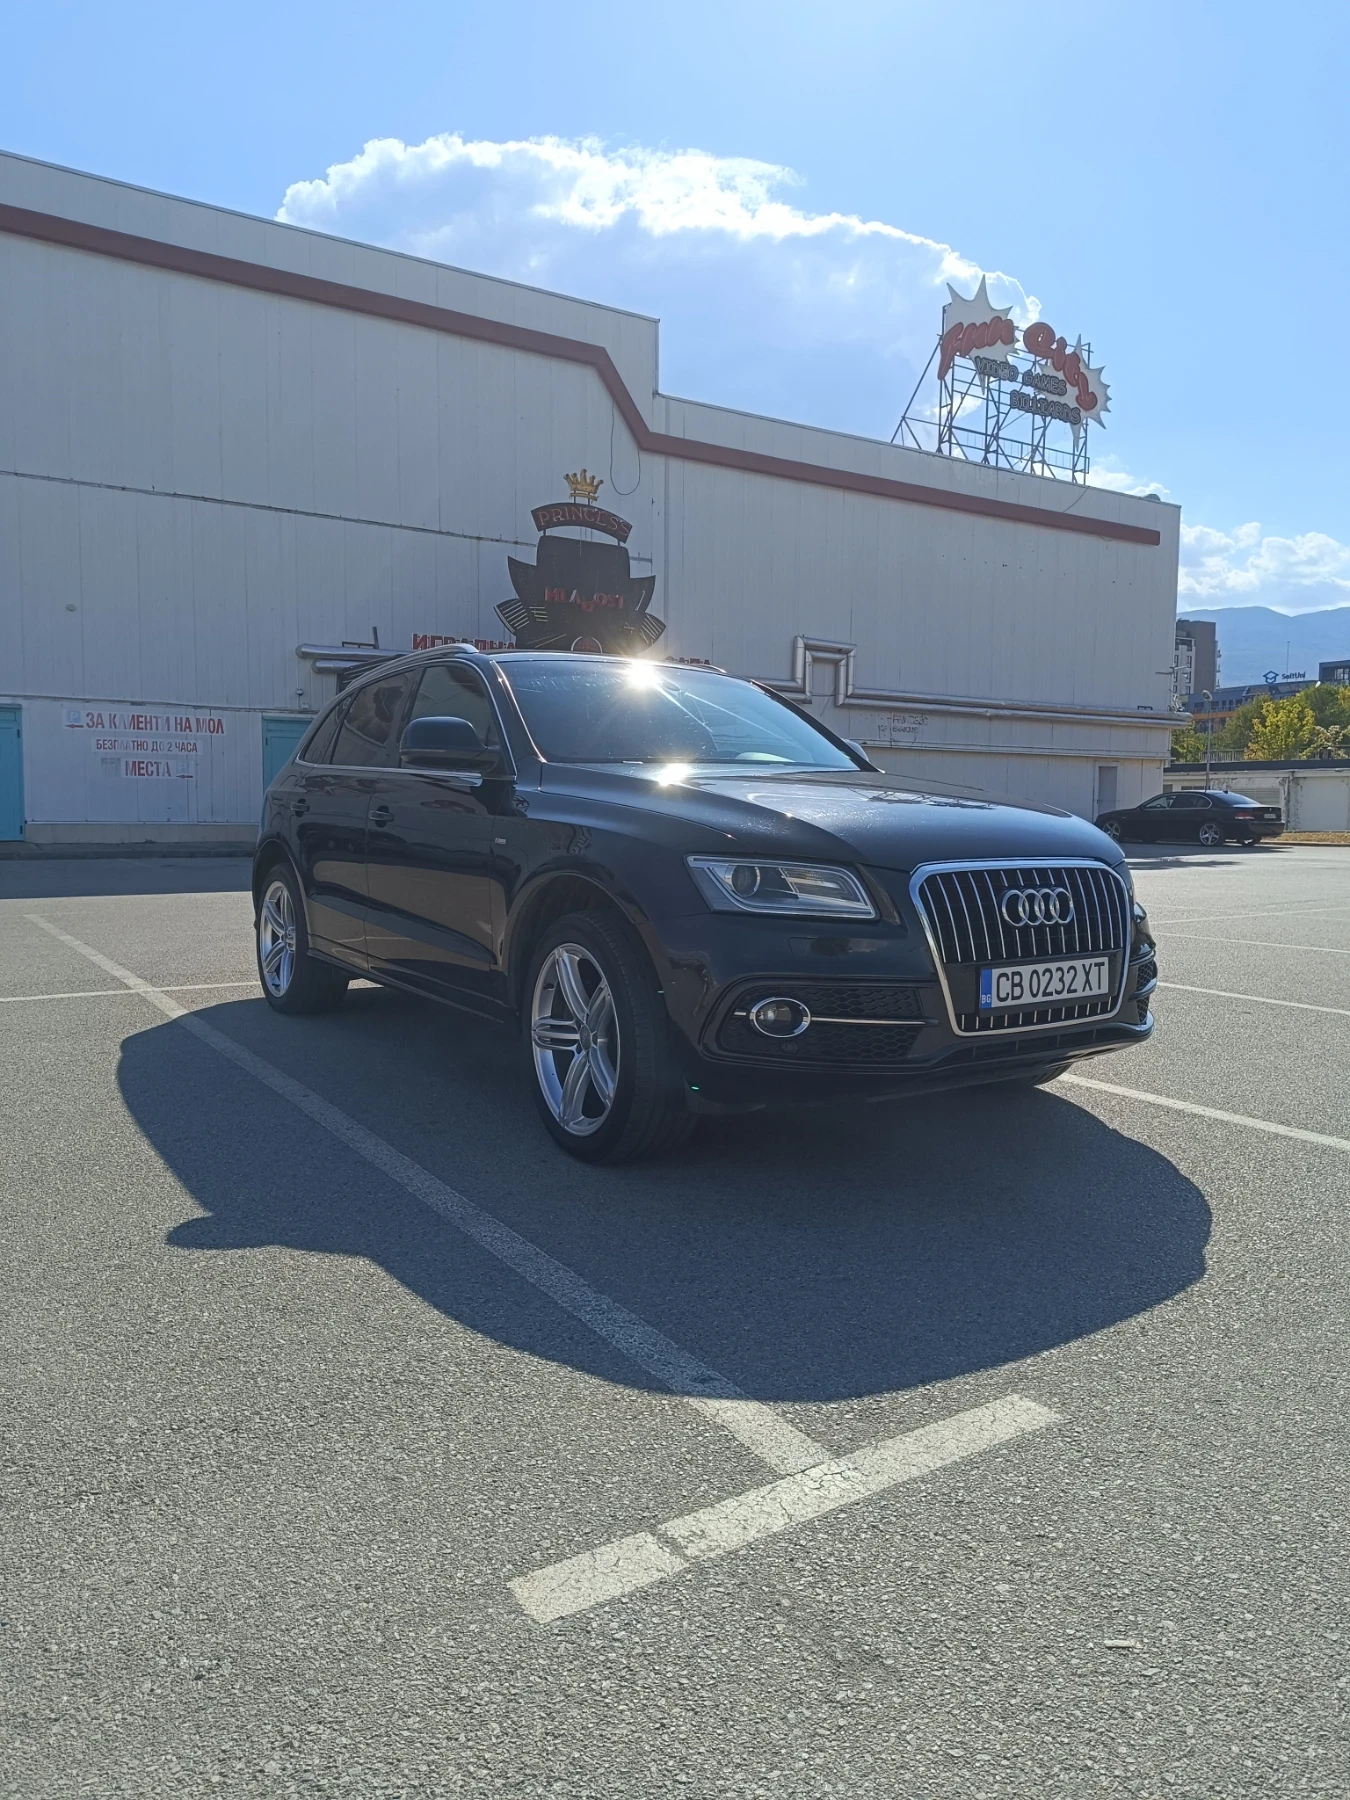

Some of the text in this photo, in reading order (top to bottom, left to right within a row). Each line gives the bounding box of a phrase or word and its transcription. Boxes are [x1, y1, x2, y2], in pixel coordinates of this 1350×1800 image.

[974, 355, 1068, 396] VIDEO GAMES
[537, 506, 630, 536] PRINCESS
[1281, 671, 1306, 680] SoftUni
[86, 712, 105, 729] ЗА
[174, 716, 193, 733] НА
[195, 717, 225, 735] МОЛ
[167, 741, 173, 752] 2
[174, 741, 198, 753] ЧАСА
[125, 760, 172, 777] МЕСТА
[996, 961, 1105, 1002] CB 0232 XT
[981, 994, 991, 1004] BG
